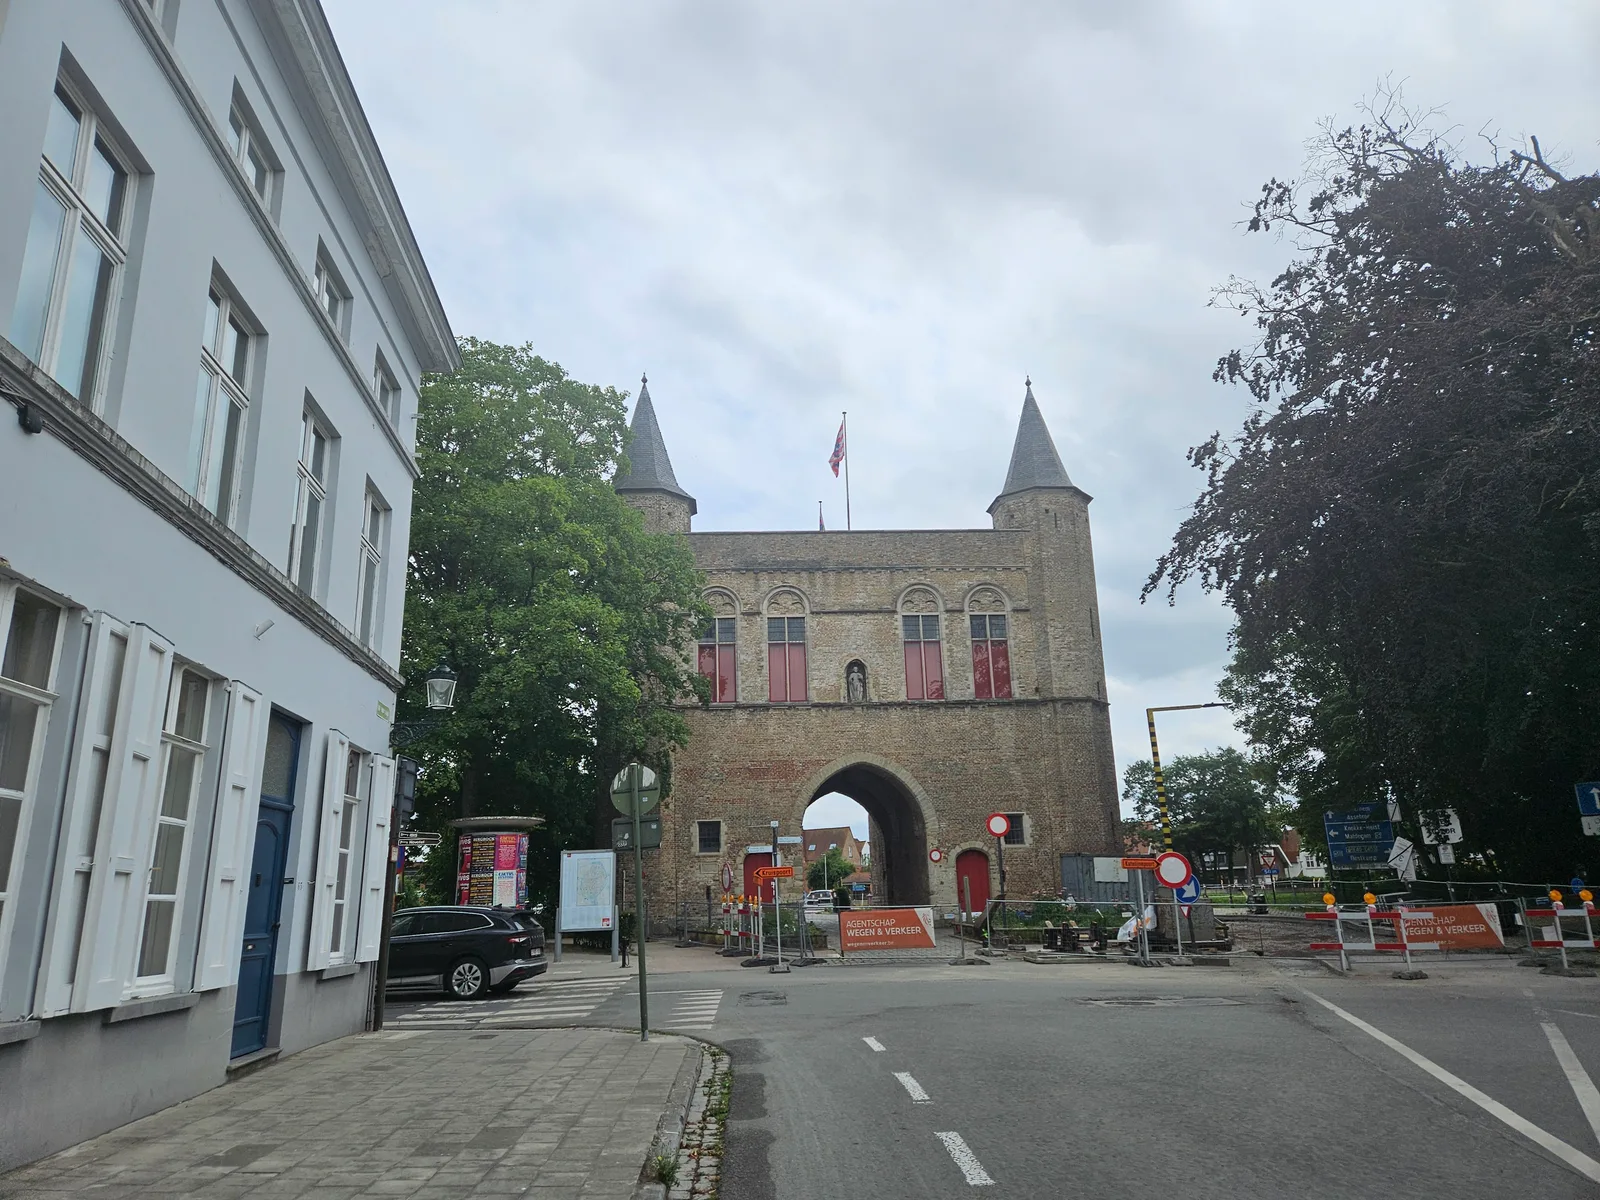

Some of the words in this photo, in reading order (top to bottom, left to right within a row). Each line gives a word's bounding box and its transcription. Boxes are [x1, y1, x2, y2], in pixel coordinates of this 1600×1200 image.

[846, 919, 896, 928] AGENTSCHAP
[847, 928, 875, 937] WEGEN
[877, 928, 883, 936] &
[885, 926, 921, 936] VERKEER
[1437, 927, 1443, 935] &
[1444, 924, 1487, 934] VERKEER
